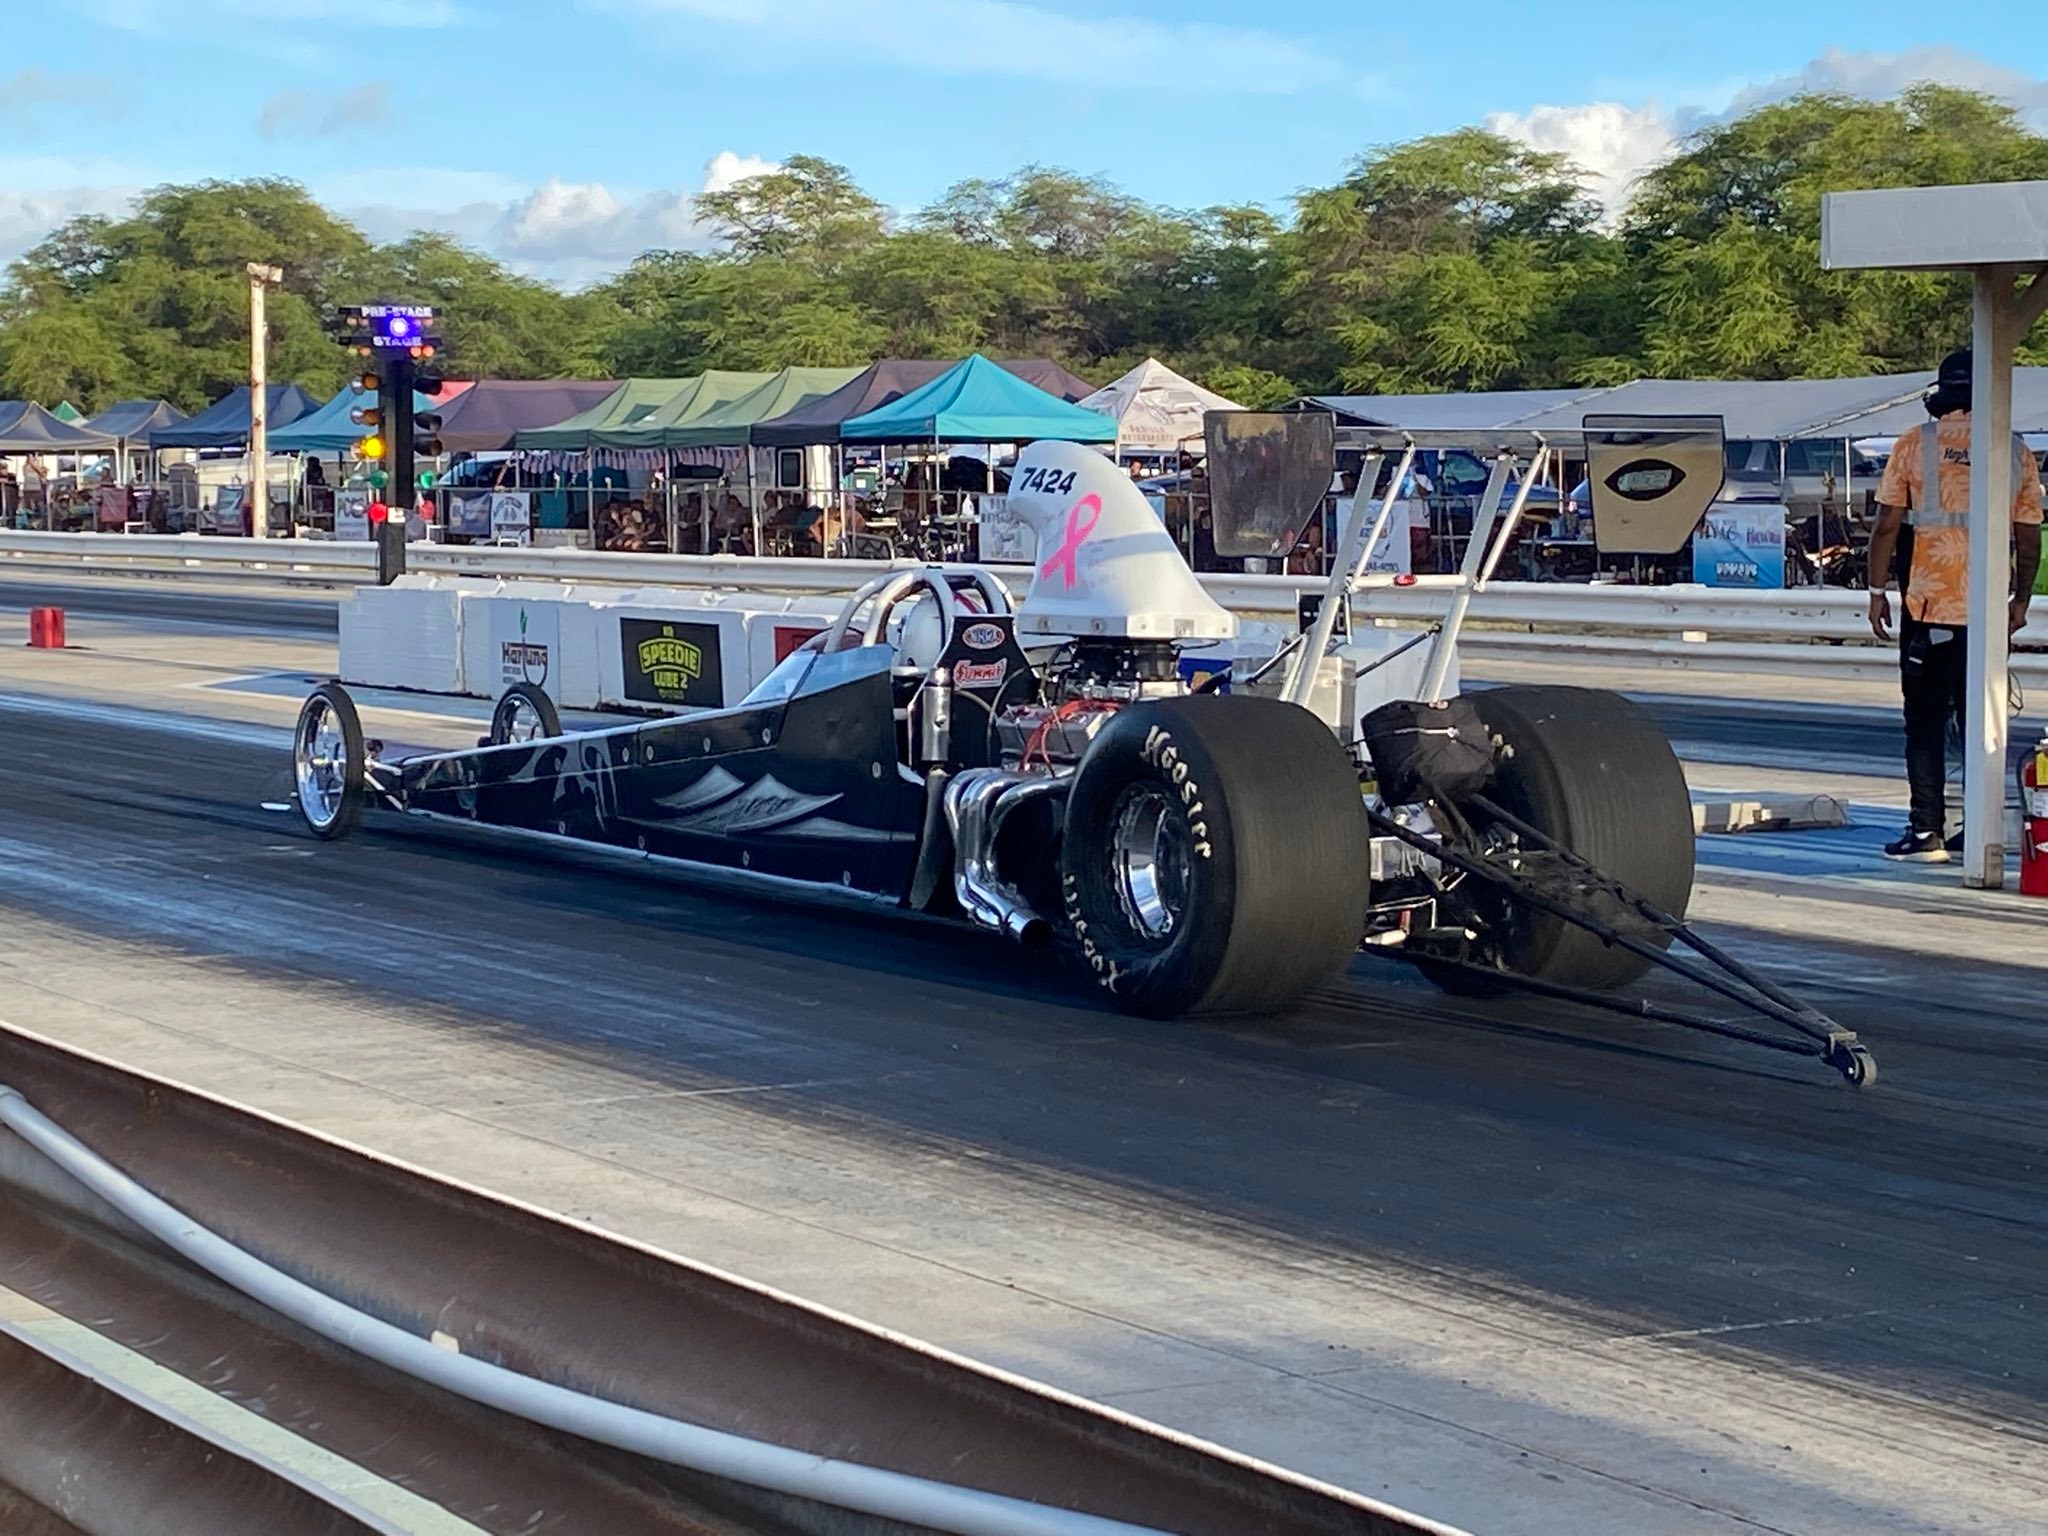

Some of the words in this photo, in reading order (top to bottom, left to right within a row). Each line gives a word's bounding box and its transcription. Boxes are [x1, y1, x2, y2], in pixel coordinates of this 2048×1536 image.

[361, 306, 432, 317] PRE-STAGE
[372, 336, 422, 347] STAGE
[1020, 467, 1077, 495] 7424
[642, 643, 698, 671] SPEEDIE
[654, 670, 679, 689] LUBE
[681, 672, 688, 689] 2
